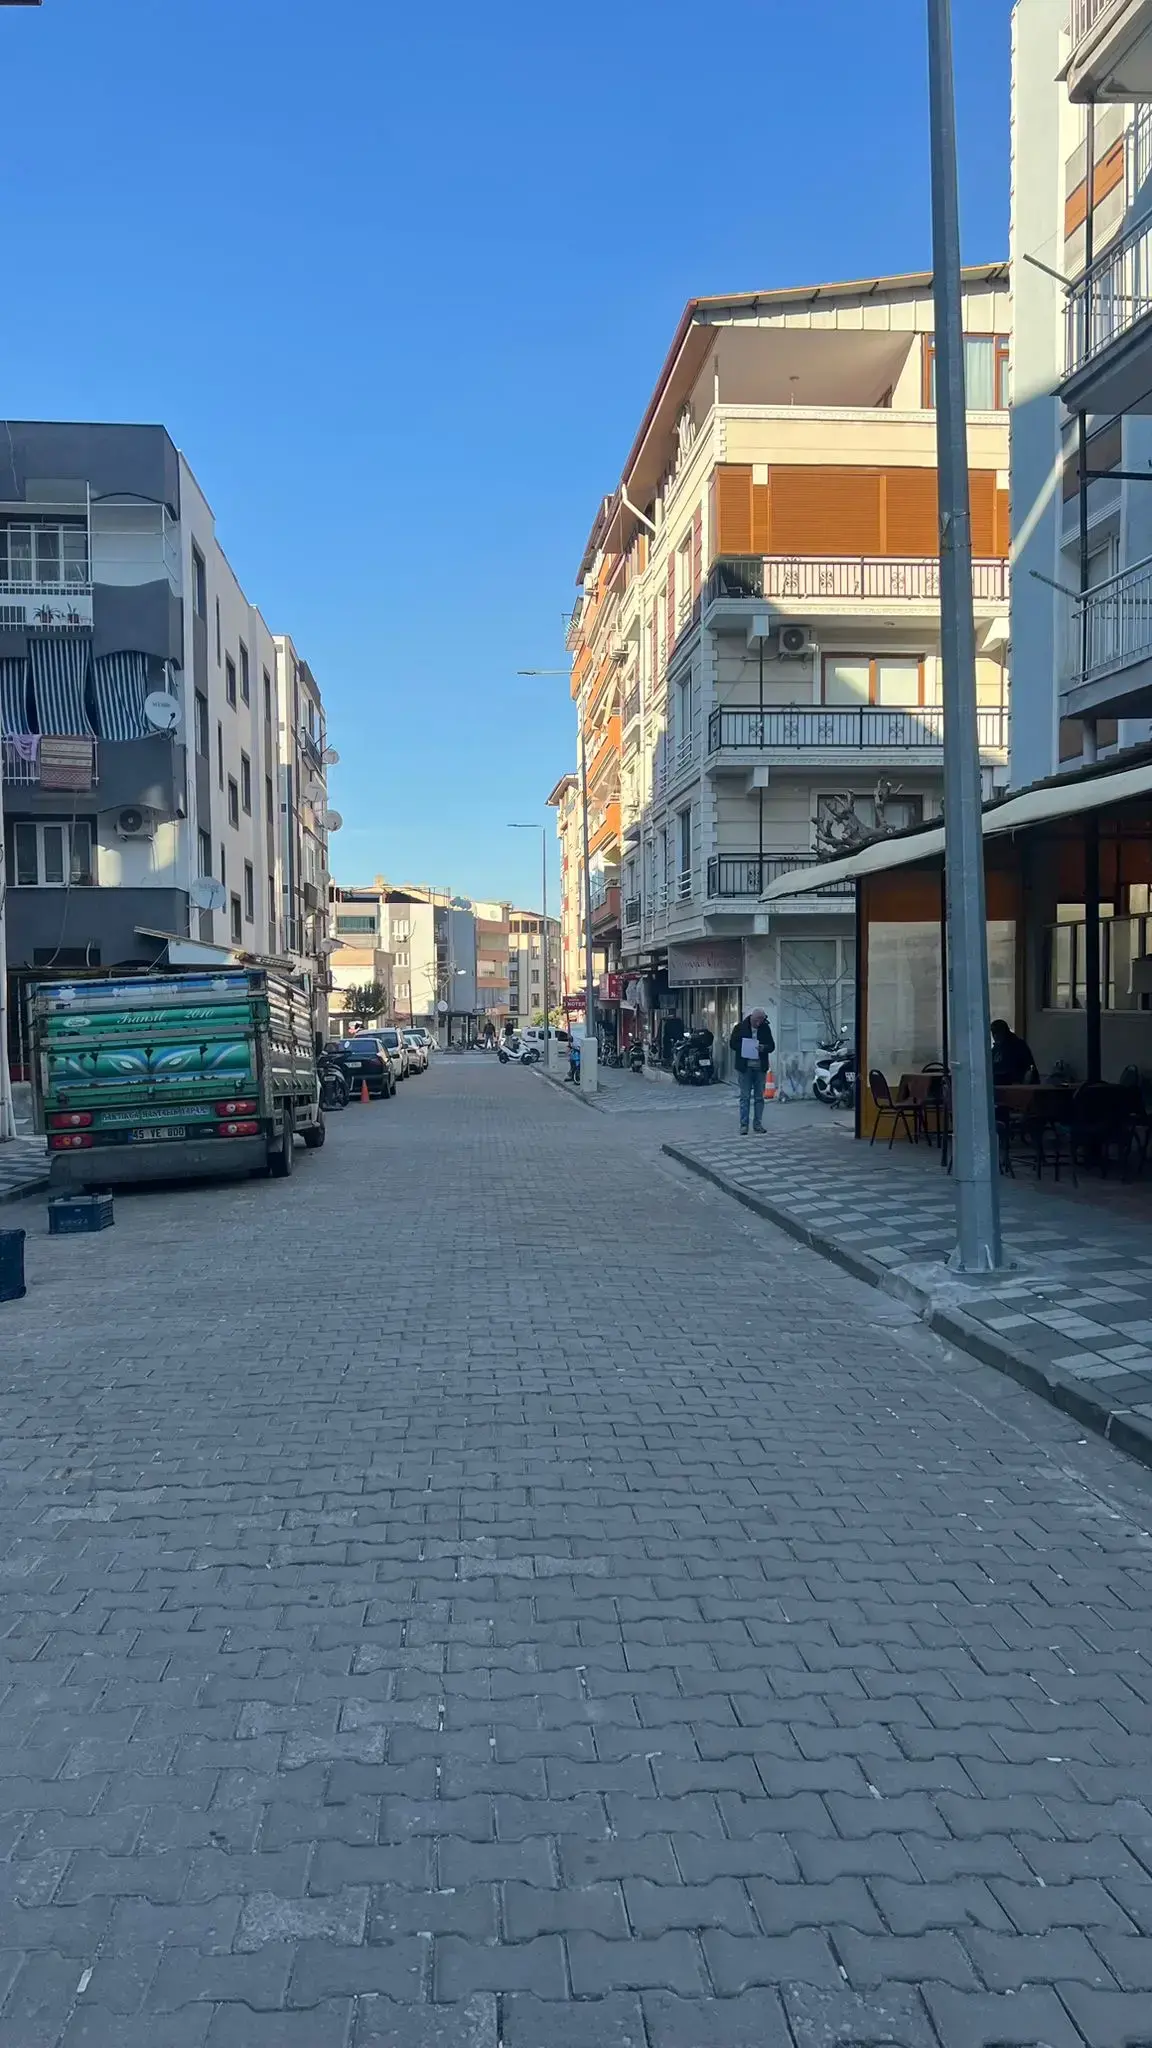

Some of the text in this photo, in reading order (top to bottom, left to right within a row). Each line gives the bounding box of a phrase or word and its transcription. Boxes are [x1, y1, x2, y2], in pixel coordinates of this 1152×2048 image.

[117, 1008, 216, 1024] Transit 2010
[133, 1128, 145, 1139] 45
[150, 1128, 161, 1138] VE
